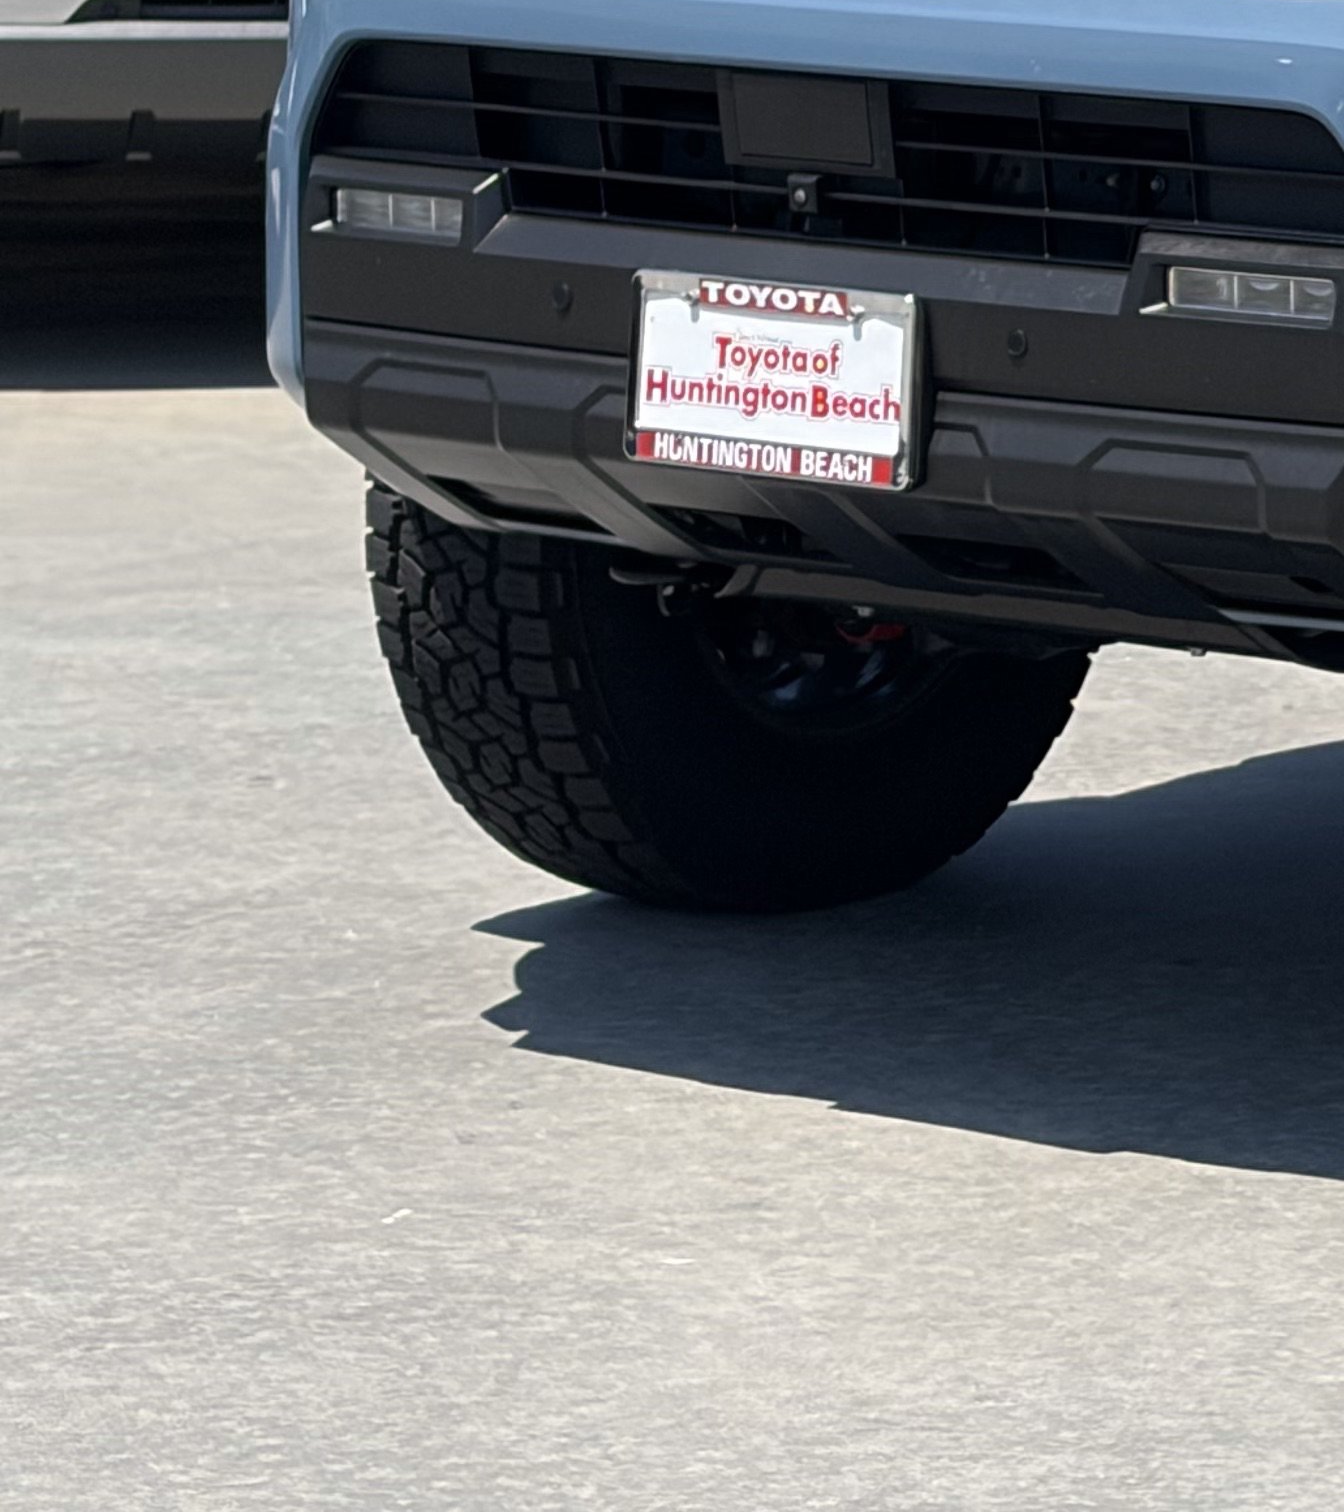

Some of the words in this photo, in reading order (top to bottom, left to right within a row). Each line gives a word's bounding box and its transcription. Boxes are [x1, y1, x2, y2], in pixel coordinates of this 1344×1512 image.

[701, 281, 844, 316] TOYOTA
[715, 336, 807, 377] Toyota
[812, 341, 841, 375] of
[646, 369, 807, 417] Huntington
[811, 385, 901, 422] Beach
[653, 432, 792, 474] HUNTINGTON
[800, 449, 873, 482] BEACH
